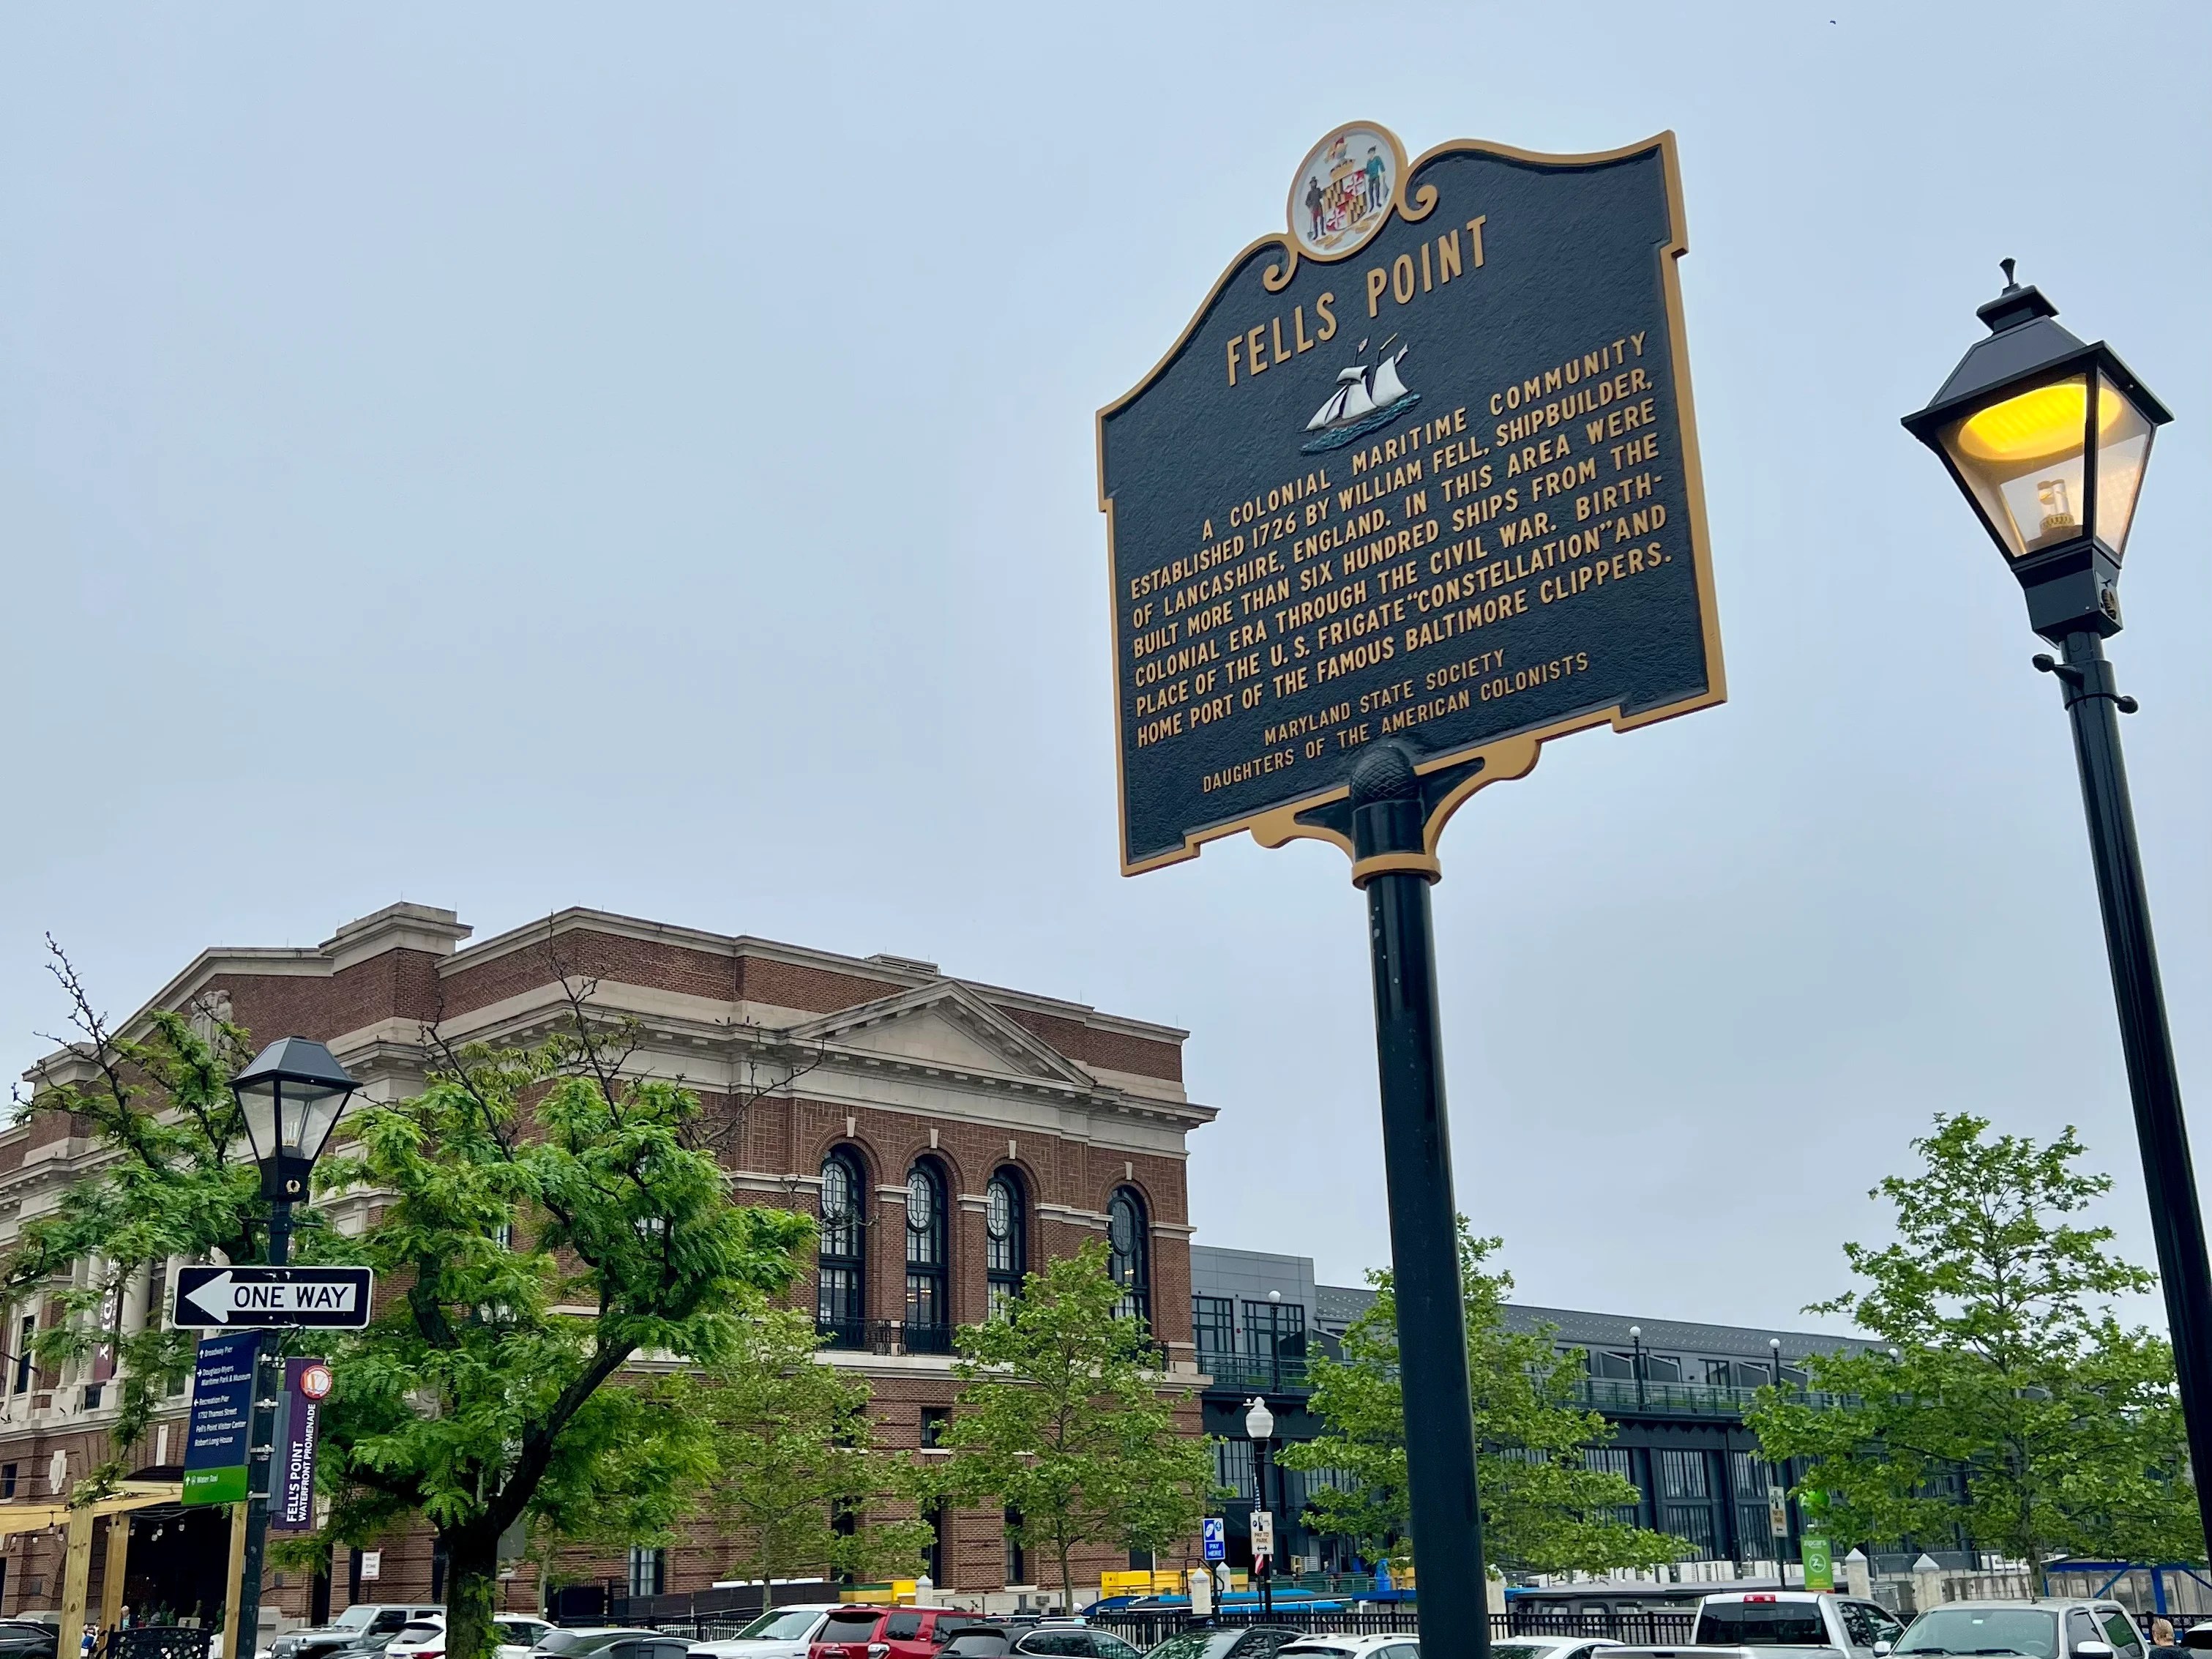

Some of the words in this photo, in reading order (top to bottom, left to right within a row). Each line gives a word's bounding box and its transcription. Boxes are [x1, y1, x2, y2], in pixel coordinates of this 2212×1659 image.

[1226, 291, 1337, 387] FELLS
[1366, 215, 1487, 318] POINT
[1130, 535, 1245, 600] ESTABLISHED
[1252, 512, 1297, 548] 1726
[1305, 499, 1329, 527] BY
[1337, 459, 1423, 512] WILLIAM
[1432, 437, 1490, 474] FELL,
[1495, 368, 1653, 447] SHIPBUILDER,
[1202, 519, 1214, 540] A
[1229, 470, 1331, 529] COLONIAL
[1351, 407, 1466, 476] MARITIME
[1490, 332, 1645, 416] COMMUNITY
[1132, 603, 1153, 630] OF
[1163, 550, 1285, 617] LANCASHIRE,
[1293, 507, 1391, 564] ENGLAND.
[1405, 491, 1427, 518] IN
[1441, 463, 1493, 502] THIS
[1507, 433, 1571, 478] AREA
[1585, 398, 1656, 446] WERE
[1133, 622, 1178, 659] BUILT
[1187, 600, 1233, 637] MORE
[1240, 578, 1290, 615] THAN
[1299, 561, 1334, 592] SIX
[1342, 519, 1439, 575] HUNDRED
[1451, 487, 1519, 533] SHIPS
[1531, 458, 1597, 502] FROM
[1610, 432, 1659, 471] THE
[1135, 639, 1221, 688] COLONIAL
[1229, 619, 1268, 652] ERA
[1275, 580, 1367, 634] THROUGH
[1378, 560, 1419, 594] THE
[1430, 537, 1488, 575] CIVIL
[1498, 511, 1556, 548] WAR.
[1575, 471, 1662, 522] BIRTH-
[1135, 679, 1189, 717] PLACE
[1195, 668, 1217, 696] OF
[1225, 652, 1260, 685] THE
[1137, 712, 1183, 748] HOME
[1189, 693, 1233, 729] PORT
[1241, 683, 1262, 710] OF
[1272, 666, 1309, 698] THE
[1316, 635, 1395, 683] FAMOUS
[1405, 589, 1528, 652] BALTIMORE
[1539, 541, 1672, 604] CLIPPERS.
[1264, 701, 1351, 745] MARYLAND
[1360, 679, 1413, 713] STATE
[1425, 649, 1503, 690] SOCIETY
[1203, 748, 1294, 794] DAUGHTERS
[1304, 737, 1323, 758] OF
[1337, 723, 1368, 747] THE
[1381, 690, 1471, 734] AMERICAN
[1480, 652, 1588, 701] COLONISTS
[234, 1286, 285, 1308] ONE
[296, 1286, 348, 1308] WAY
[286, 1482, 299, 1522] FELL'S
[290, 1441, 304, 1480] POINT
[298, 1461, 311, 1521] WATERFRONT
[304, 1403, 316, 1459] PROMENADE
